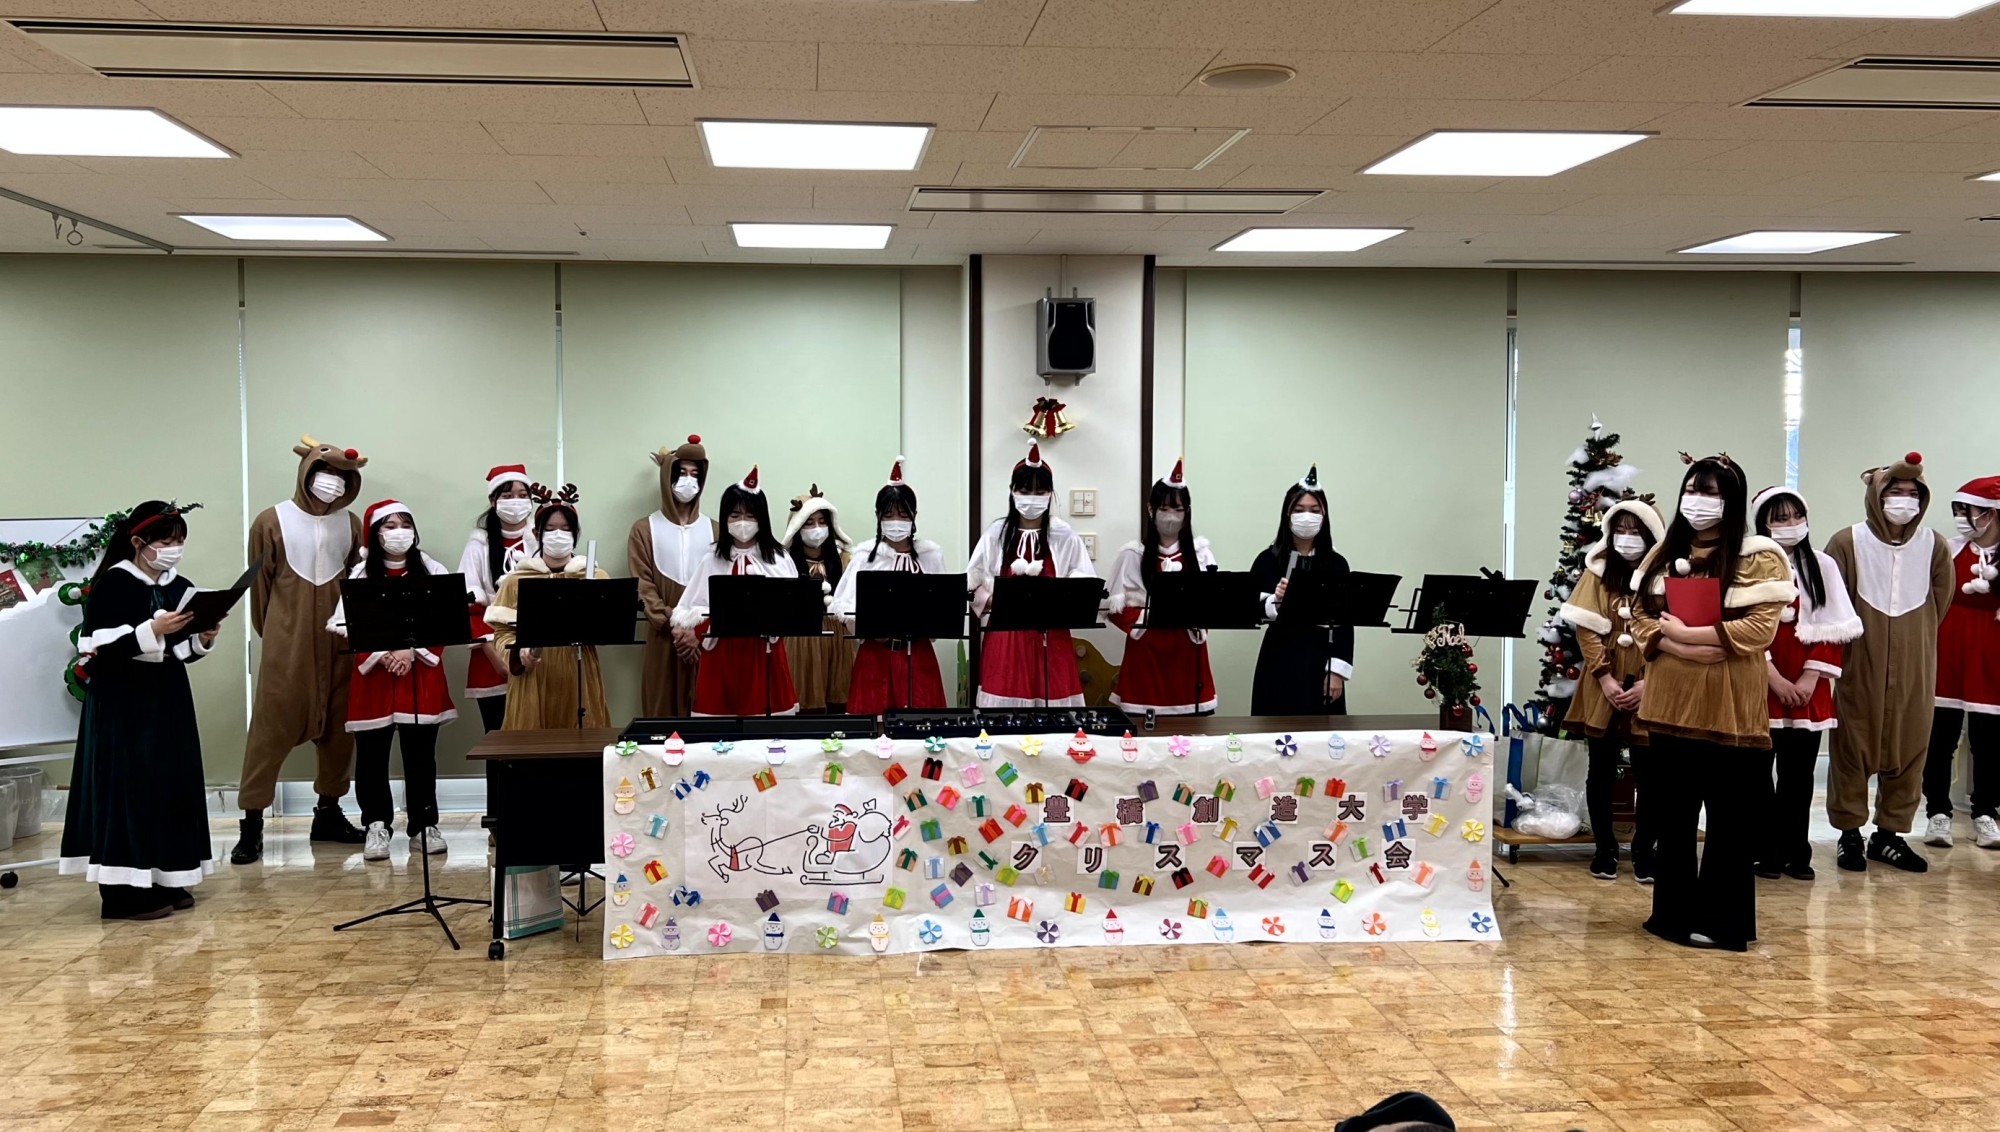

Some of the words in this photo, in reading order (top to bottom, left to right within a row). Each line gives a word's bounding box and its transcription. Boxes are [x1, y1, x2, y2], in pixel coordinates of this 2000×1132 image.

[1043, 795, 1428, 825] 豊橋創造大学
[1013, 841, 1412, 873] クリスマス会
